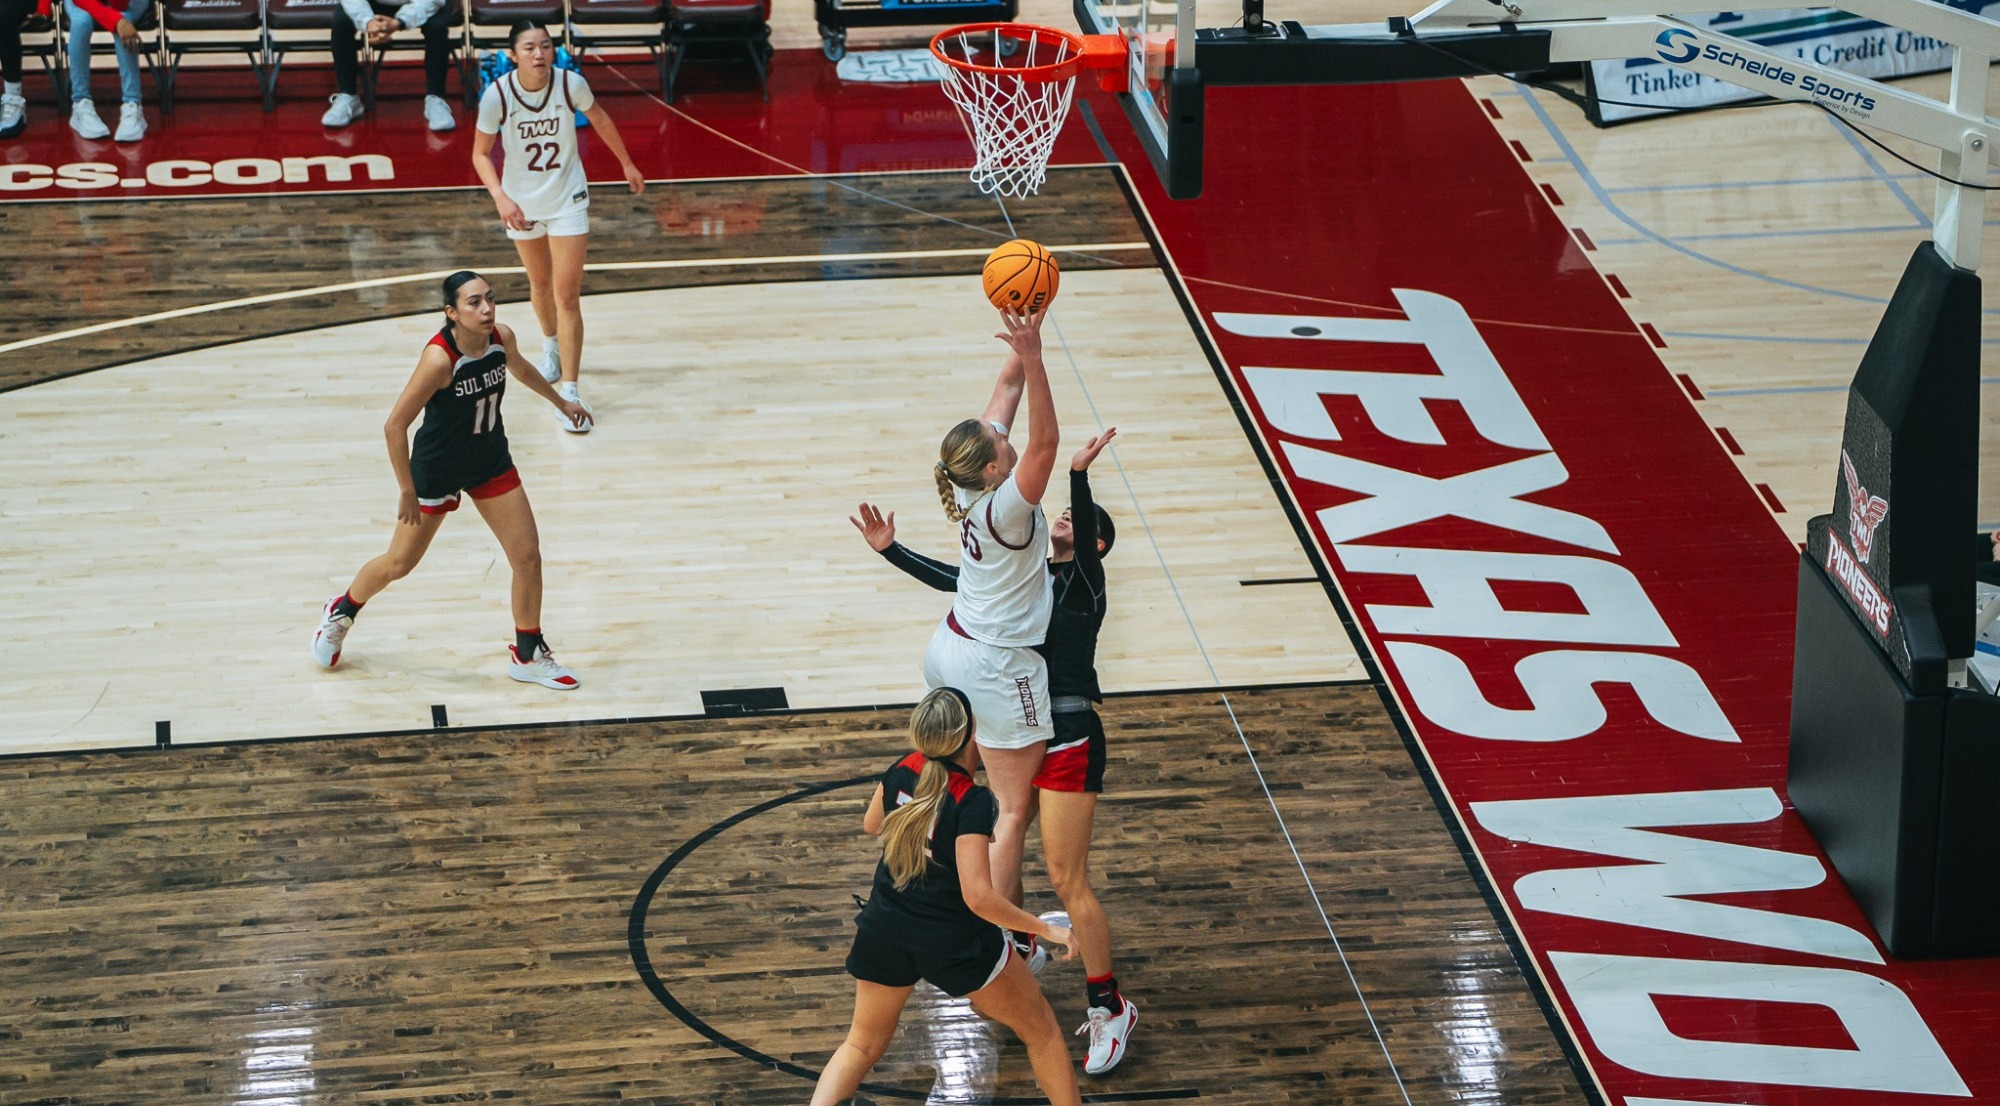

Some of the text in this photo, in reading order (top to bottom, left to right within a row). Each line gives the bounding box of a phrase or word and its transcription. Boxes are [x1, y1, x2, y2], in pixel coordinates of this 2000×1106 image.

[1814, 36, 1887, 65] Credit
[1702, 44, 1876, 111] Schelde Sports
[517, 117, 560, 139] TWU
[1841, 105, 1849, 113] by
[1849, 107, 1871, 119] Design
[525, 142, 561, 171] 22
[455, 377, 482, 397] SUL
[473, 392, 498, 434] 11
[1852, 511, 1871, 547] TWU
[1827, 532, 1890, 633] PIONEERS
[1014, 676, 1039, 726] PIONEERS
[1211, 287, 1974, 1106] TEXAS WO
